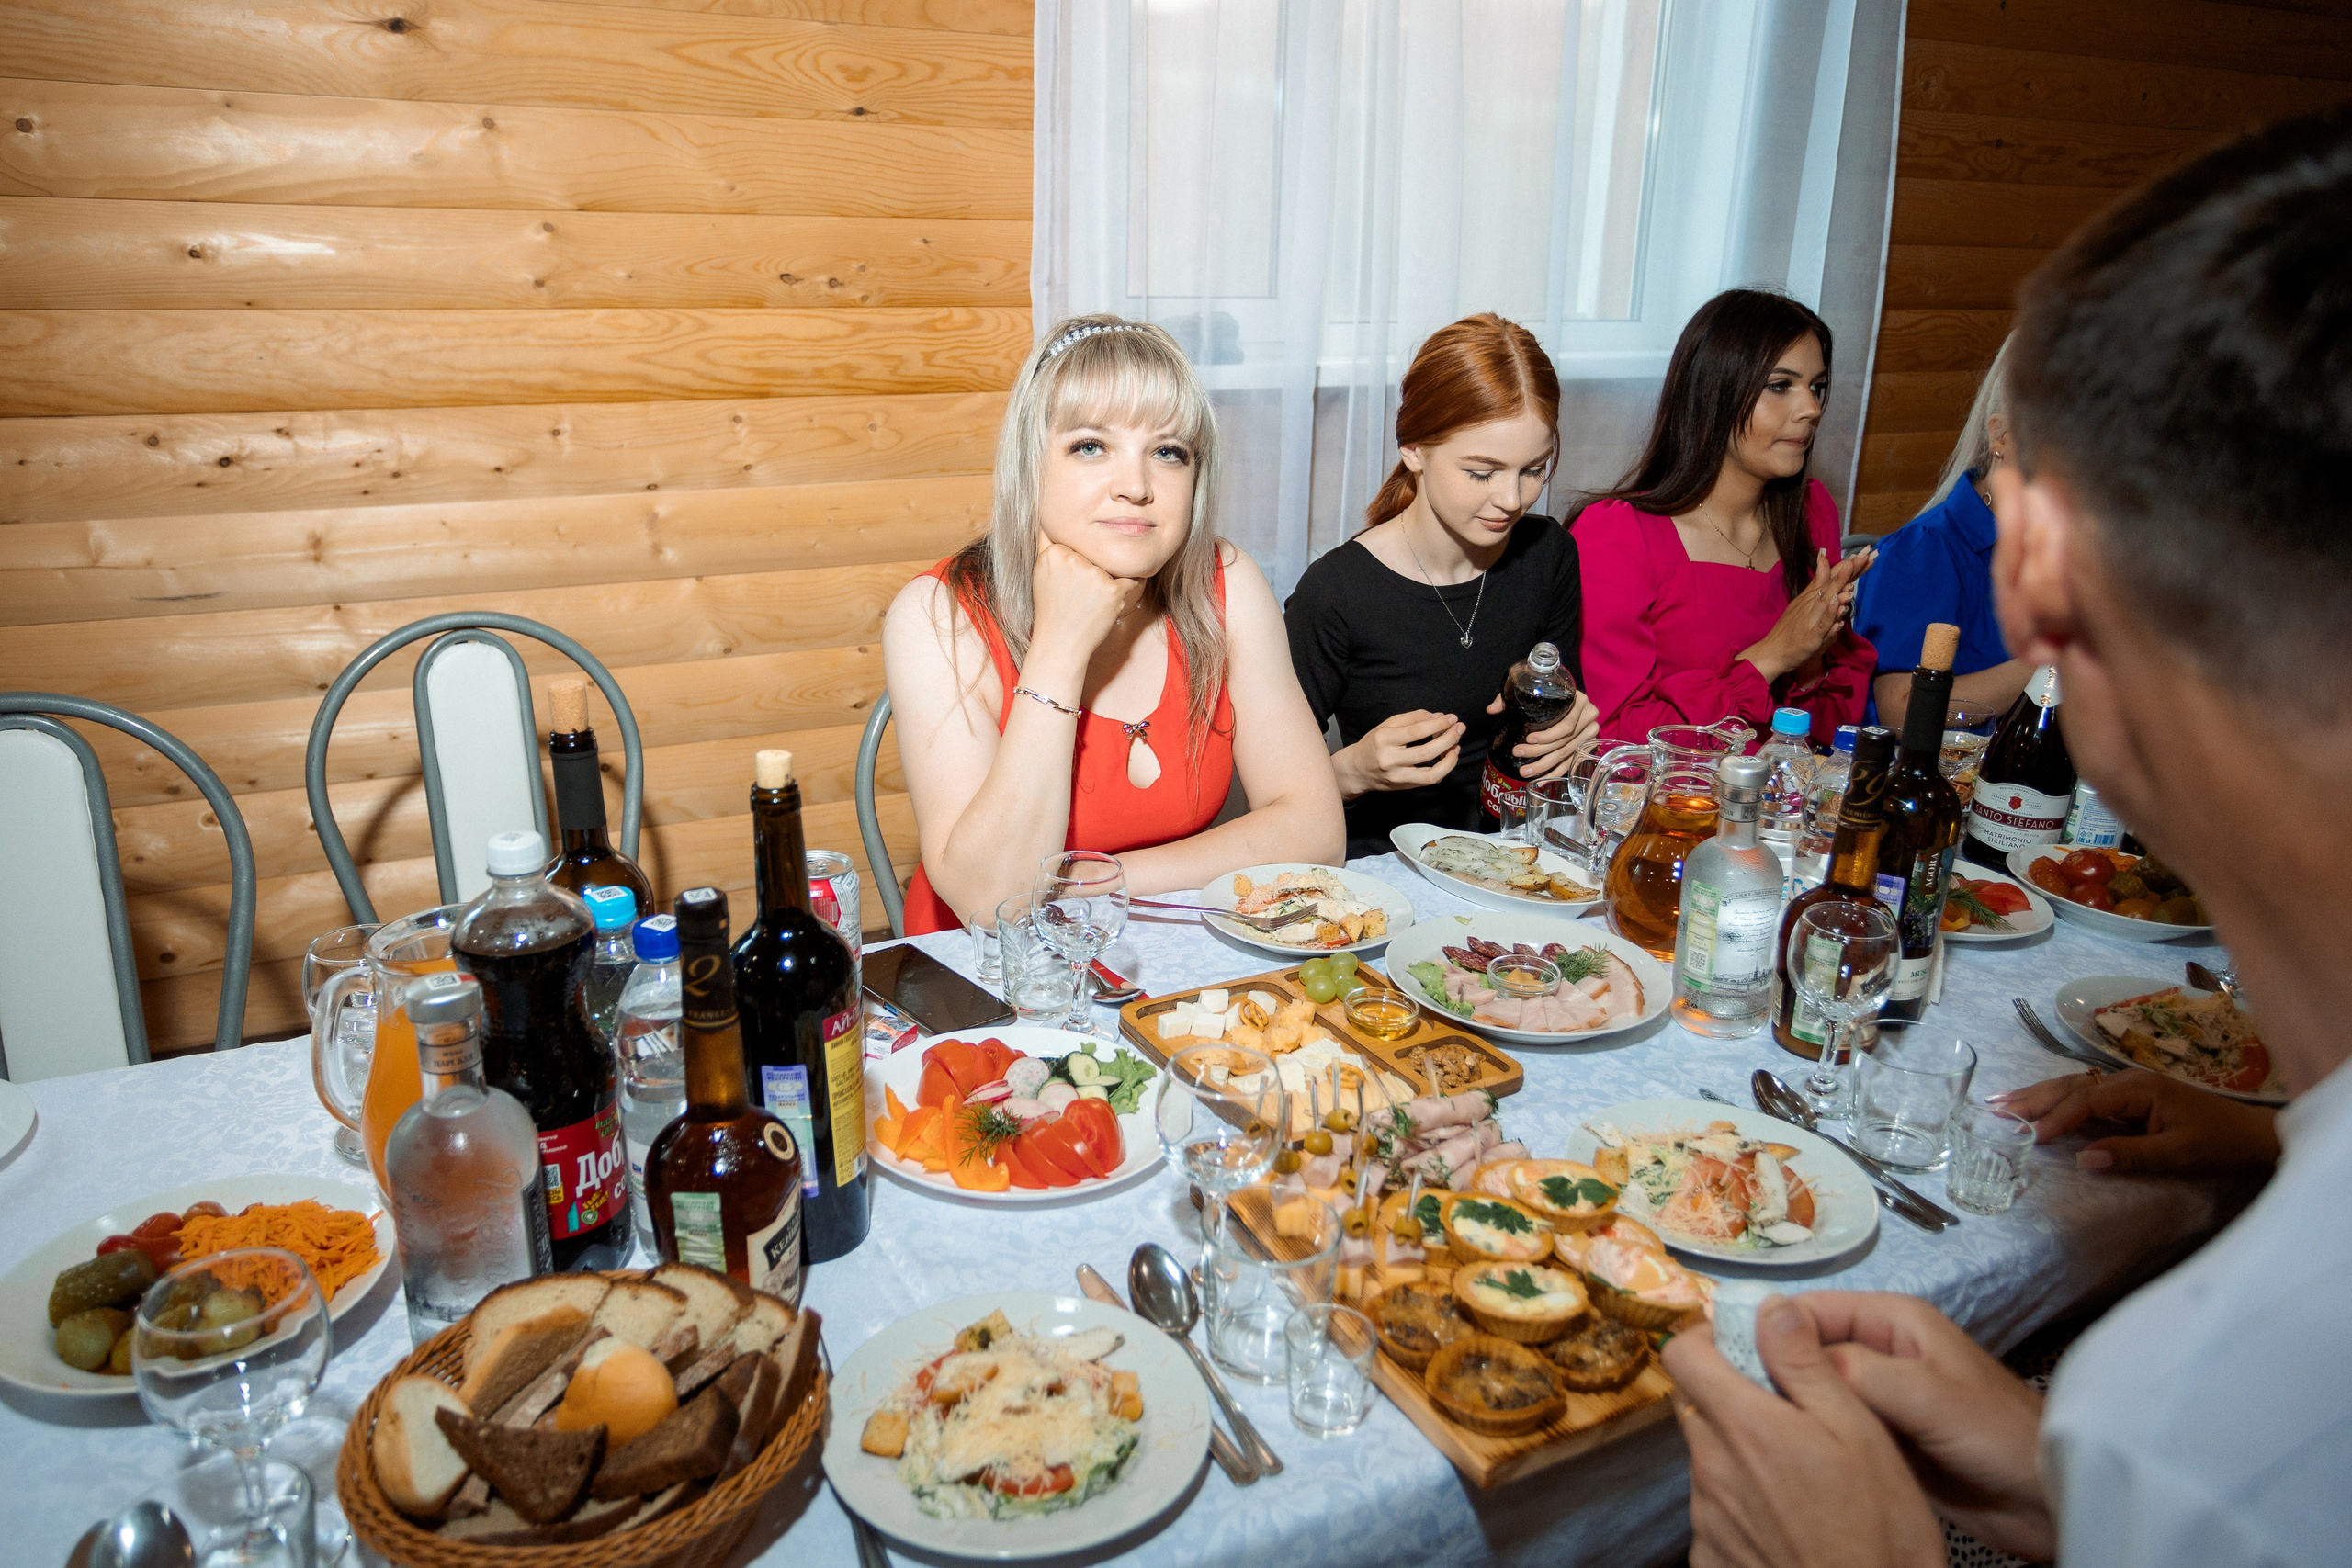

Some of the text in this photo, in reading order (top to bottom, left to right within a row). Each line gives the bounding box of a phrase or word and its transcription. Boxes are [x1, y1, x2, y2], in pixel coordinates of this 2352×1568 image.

[1974, 804, 2003, 822] SANTO
[2007, 816, 2054, 829] STEFANO
[1984, 829, 2032, 844] MATRIMONIO
[1925, 852, 1939, 888] AGORA
[575, 1130, 625, 1199] Доб
